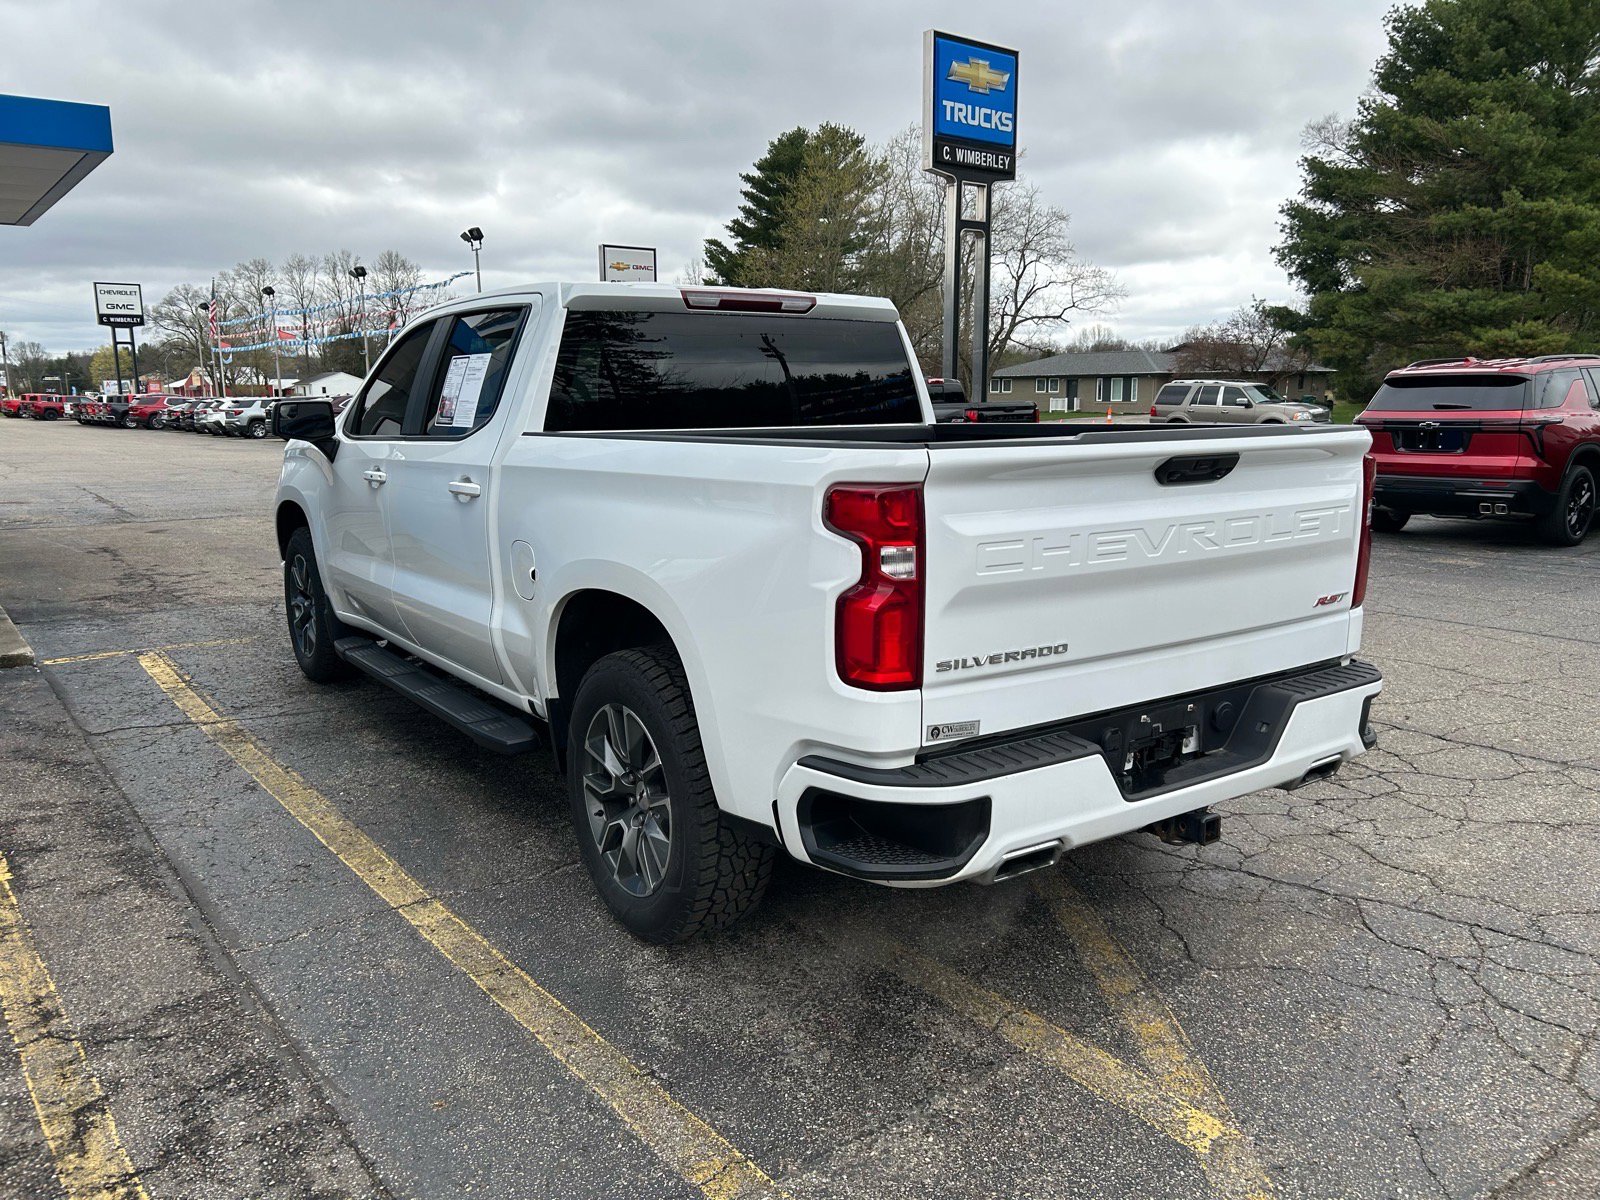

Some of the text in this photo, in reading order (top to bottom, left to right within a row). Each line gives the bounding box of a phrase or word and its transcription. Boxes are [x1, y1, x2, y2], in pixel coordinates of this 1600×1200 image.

[942, 99, 1013, 132] TRUCKS
[943, 145, 1010, 170] C. WIMBERLEY
[632, 264, 654, 272] GMC
[105, 303, 135, 311] GMC
[975, 504, 1351, 577] CHEVROLET
[1312, 591, 1349, 608] RST
[935, 643, 1069, 673] SILVERADO
